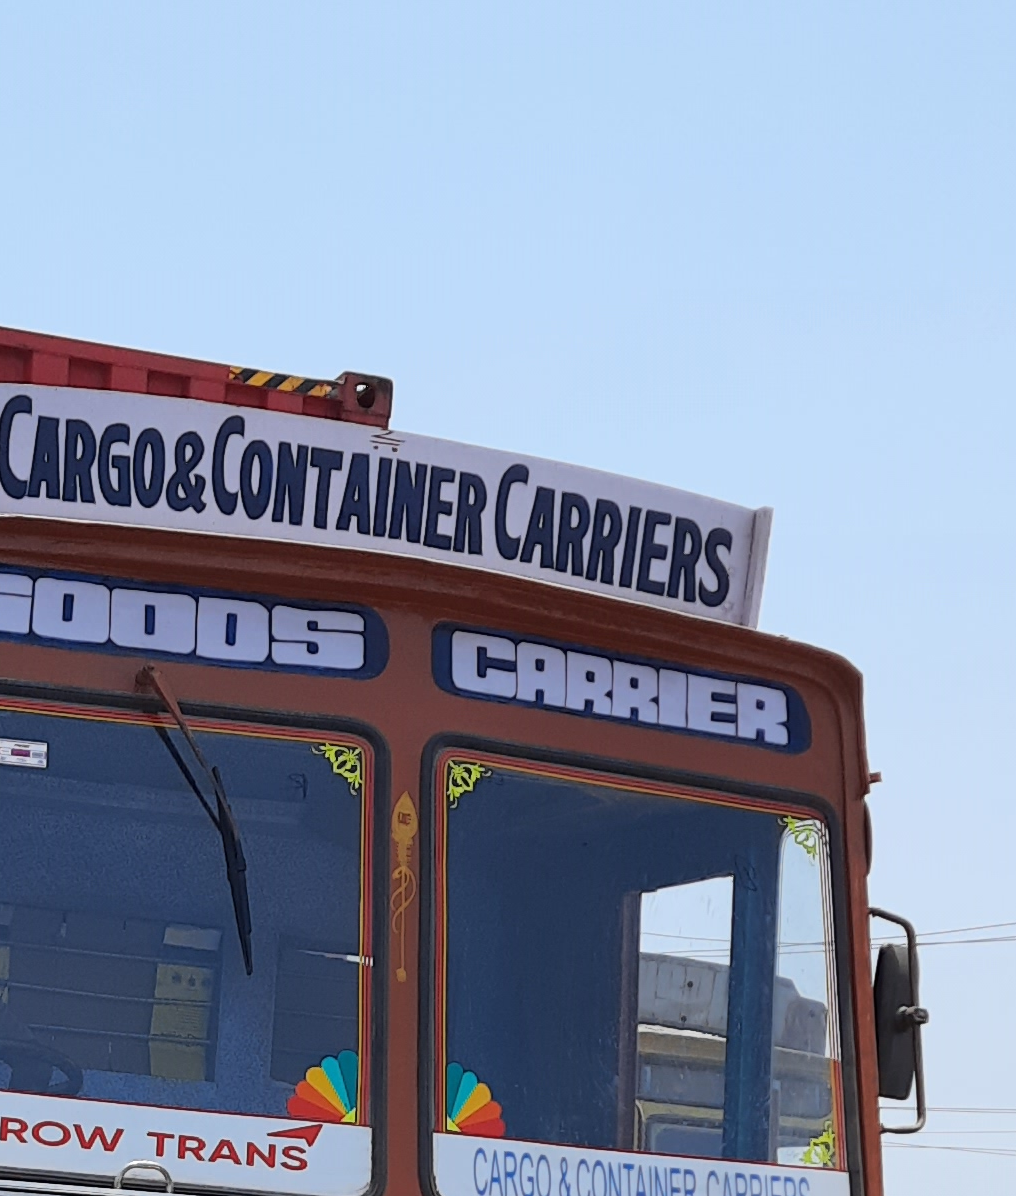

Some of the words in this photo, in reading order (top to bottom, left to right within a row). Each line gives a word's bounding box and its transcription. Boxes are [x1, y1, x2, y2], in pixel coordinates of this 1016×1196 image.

[494, 463, 733, 608] CARRIERS
[451, 629, 789, 746] CARRIER
[146, 1130, 309, 1171] TRANS
